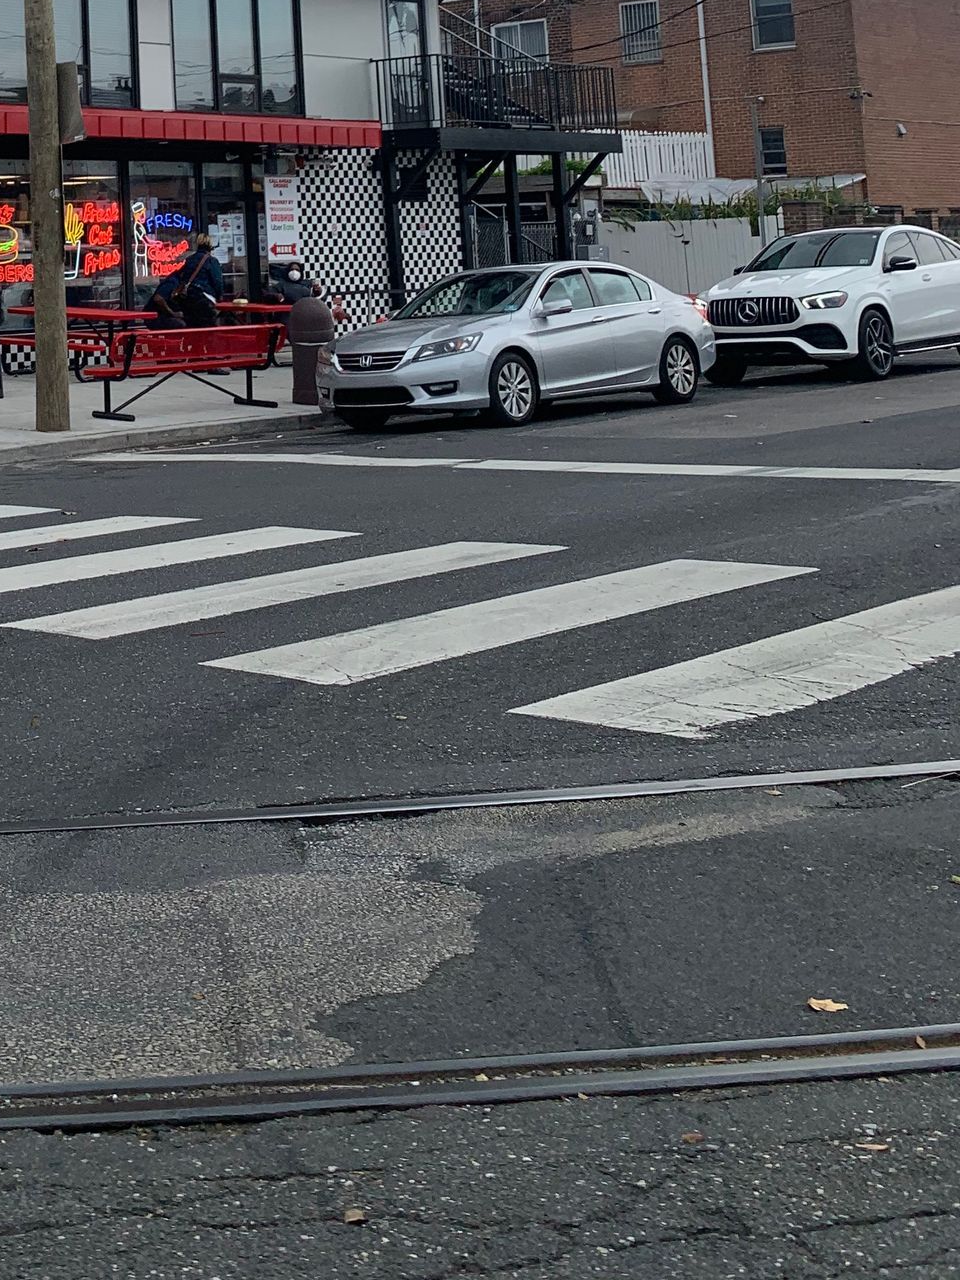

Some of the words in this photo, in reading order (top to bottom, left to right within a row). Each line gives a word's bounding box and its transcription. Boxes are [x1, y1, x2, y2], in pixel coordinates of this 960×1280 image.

[83, 202, 120, 223] Fresh
[146, 213, 193, 233] FRESH
[88, 224, 113, 246] Cut
[276, 245, 292, 253] HERE
[84, 249, 121, 276] Fries
